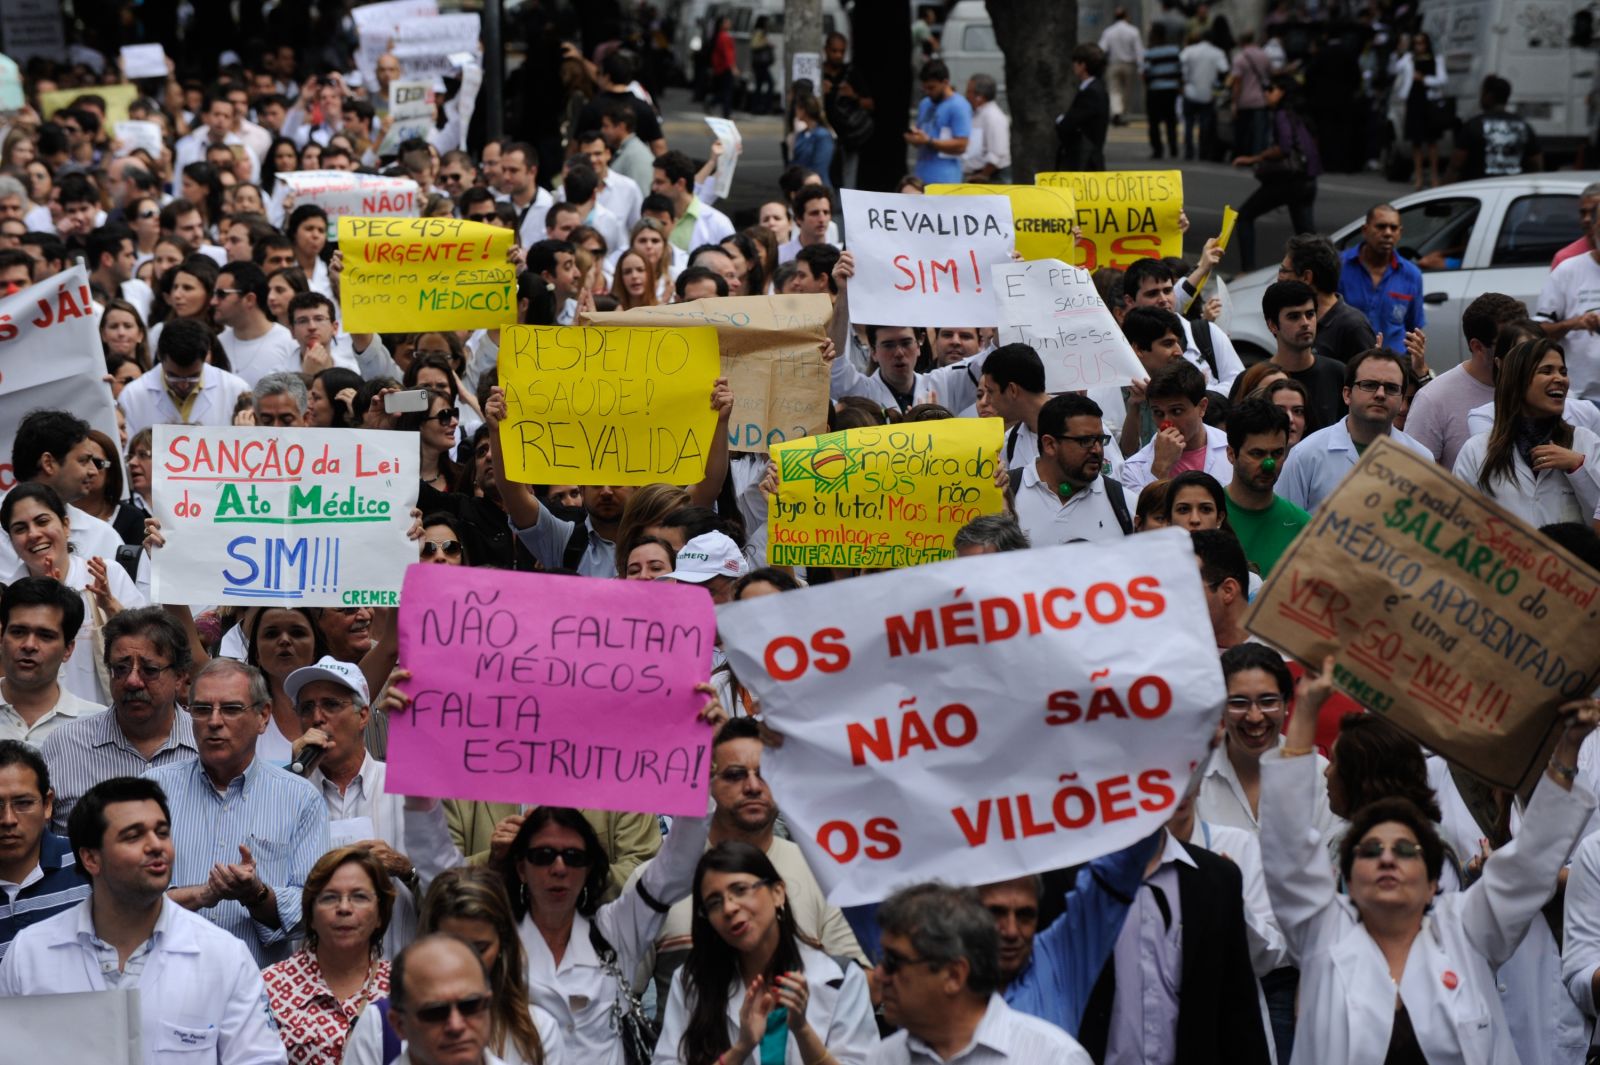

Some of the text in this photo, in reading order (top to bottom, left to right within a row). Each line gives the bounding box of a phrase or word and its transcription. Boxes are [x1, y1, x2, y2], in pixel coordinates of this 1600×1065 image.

[362, 191, 413, 214] NÃO!
[868, 207, 1009, 239] REVALIDA,
[1127, 207, 1158, 233] DA
[348, 219, 402, 237] PEC
[411, 219, 464, 238] 454
[1015, 217, 1074, 235] CREMERJ
[348, 267, 515, 286] Carreira de ESTADO
[893, 248, 982, 294] SIM!
[1005, 265, 1032, 298] É
[351, 285, 512, 313] para o MÉDICO!
[505, 325, 690, 376] RESPEITO
[528, 377, 655, 417] SAÚDE!
[164, 435, 400, 479] SANÇÃO da Lei
[511, 420, 704, 475] REVALIDA
[860, 446, 995, 480] médica do
[173, 489, 202, 518] do
[834, 492, 885, 521] luta!
[888, 495, 928, 522] Mas
[937, 503, 982, 524] não
[938, 480, 981, 505] não
[815, 524, 890, 554] milagre
[905, 530, 945, 550] sem
[1315, 510, 1423, 588] MÉDICO
[1365, 491, 1381, 509] o
[1519, 587, 1549, 620] do
[222, 535, 341, 594] SIM!!!
[421, 590, 702, 658] NÃO FALTAM
[763, 575, 1167, 682] OS MÉDICOS
[1409, 610, 1459, 653] uma
[475, 643, 673, 696] MÉDICOS,
[411, 690, 542, 734] FALTA
[845, 667, 1173, 767] NÃO SÃO
[462, 739, 707, 790] ESTRUTURA!
[815, 816, 902, 865] OS
